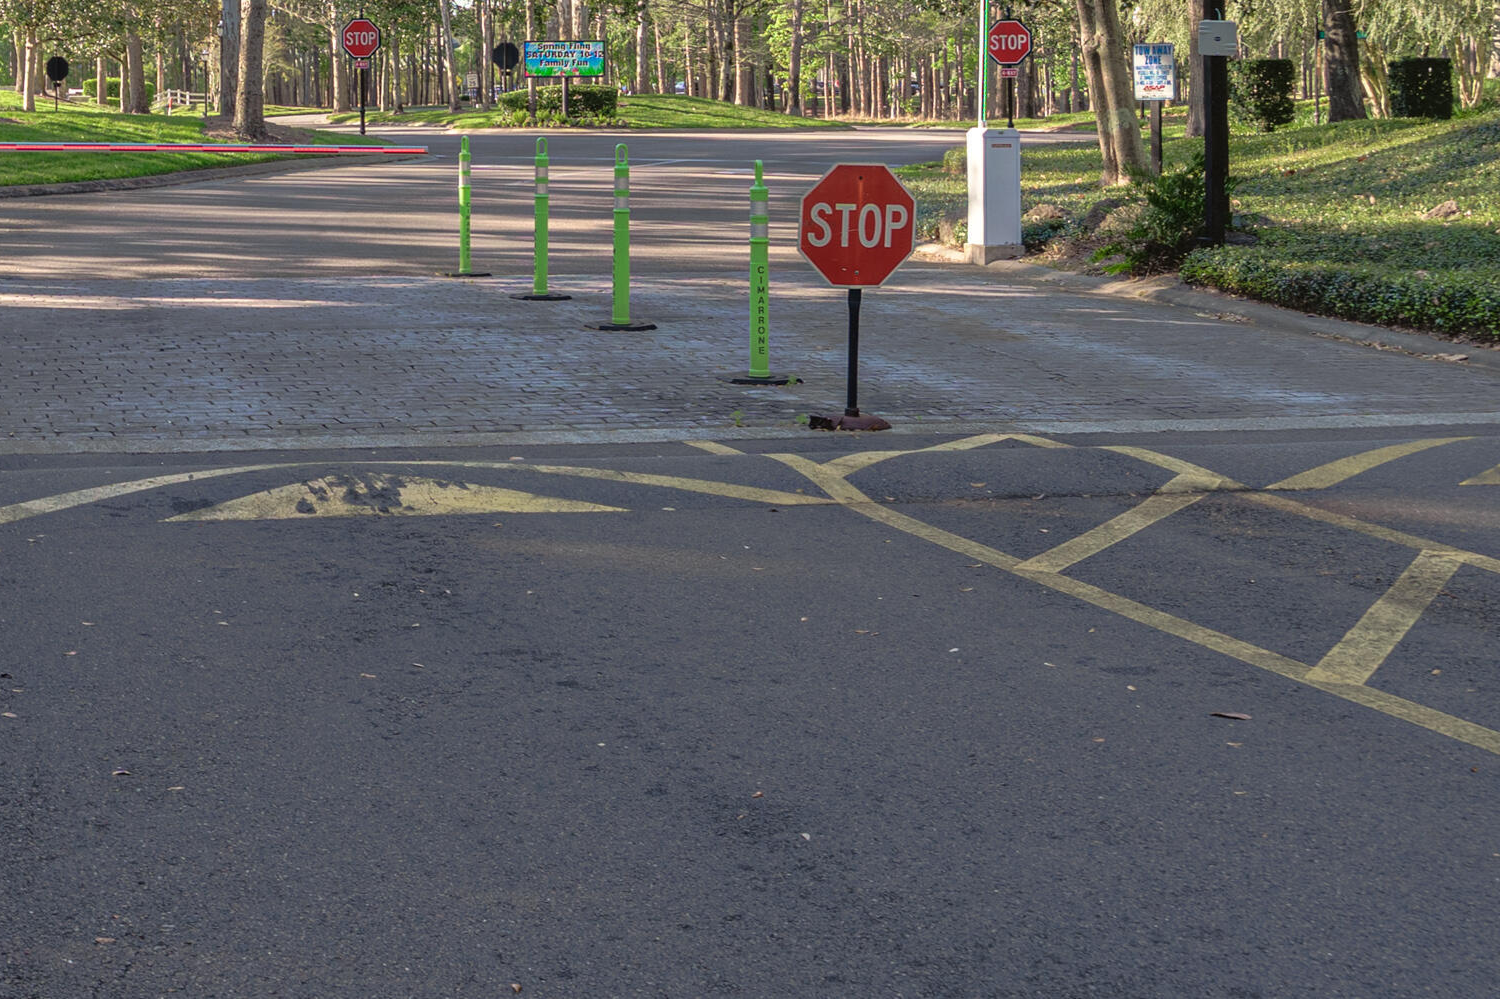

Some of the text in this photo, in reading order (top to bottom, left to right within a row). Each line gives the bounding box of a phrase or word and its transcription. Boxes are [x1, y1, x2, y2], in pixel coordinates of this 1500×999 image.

[346, 31, 376, 46] STOP
[990, 34, 1027, 50] STOP
[537, 42, 591, 51] Spring Fling
[1135, 45, 1172, 55] TOW AWAY
[539, 59, 570, 67] Family
[1145, 55, 1161, 65] ZONE
[807, 202, 909, 249] STOP
[757, 265, 765, 355] CIMARRONE
